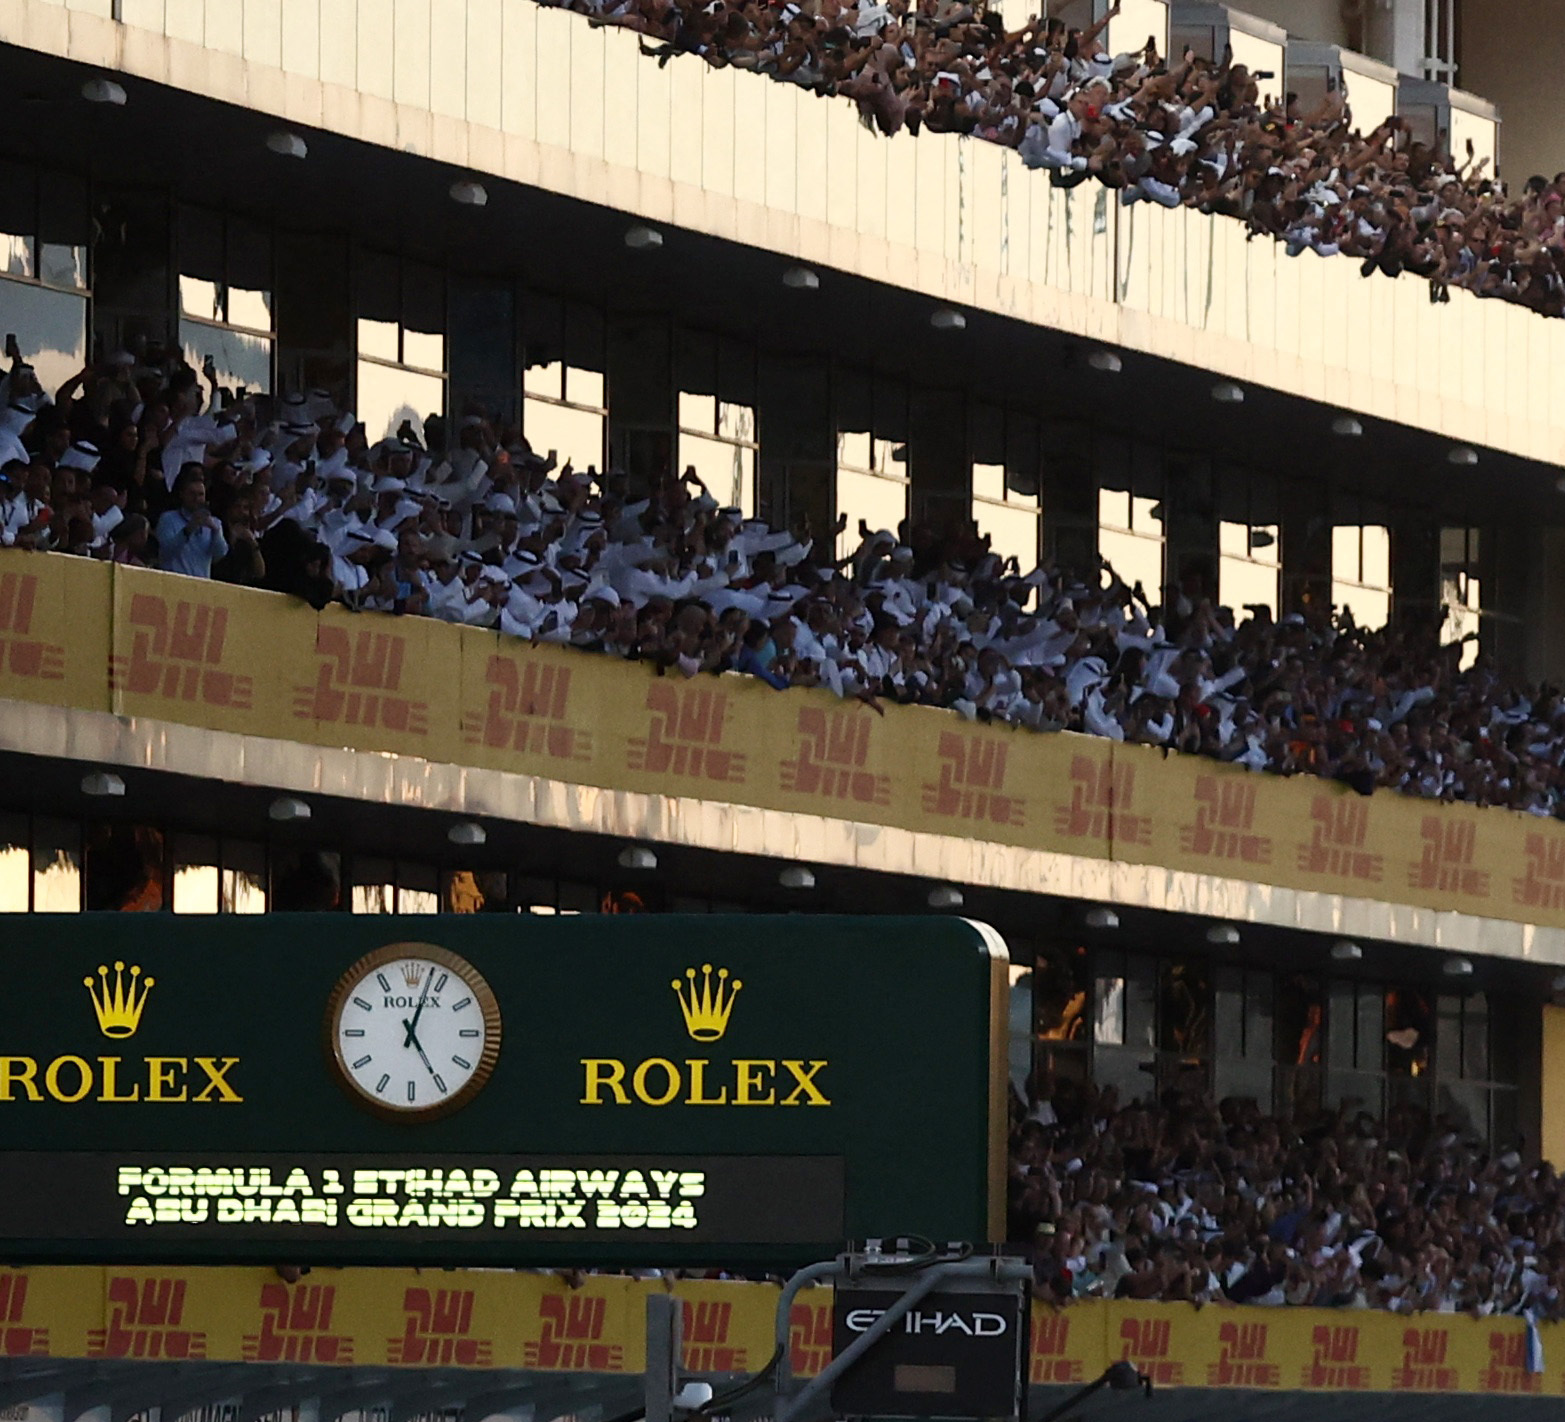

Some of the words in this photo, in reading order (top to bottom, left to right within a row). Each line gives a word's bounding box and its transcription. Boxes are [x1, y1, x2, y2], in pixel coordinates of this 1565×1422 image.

[115, 594, 245, 708] DHL
[301, 624, 420, 734] DHL
[472, 655, 584, 757] DHL
[634, 682, 739, 783] DHL
[787, 708, 885, 806] DHL
[927, 732, 1019, 826] DHL
[1060, 757, 1147, 847] DHL
[1186, 776, 1266, 864] DHL
[1301, 795, 1378, 881] DHL
[1414, 816, 1483, 896] DHL
[0, 1055, 243, 1103] ROLEX
[580, 1058, 831, 1106] ROLEX
[118, 1167, 313, 1196] FORMULA
[322, 1168, 345, 1196] 1
[354, 1168, 500, 1198] ETIHAD
[510, 1169, 705, 1199] AIRWAYS
[126, 1197, 209, 1226] ABU
[217, 1198, 338, 1227] DHABI
[347, 1198, 486, 1229] GRAND
[494, 1199, 586, 1229] PRIX
[596, 1200, 698, 1229] 2024
[93, 1277, 199, 1358] DHL
[248, 1283, 348, 1363] DHL
[394, 1288, 485, 1365] DHL
[531, 1294, 618, 1370] DHL
[845, 1310, 1006, 1337] EIHAD
[1213, 1322, 1275, 1386] DHL
[1307, 1325, 1364, 1388] DHL
[1398, 1327, 1455, 1390] DHL
